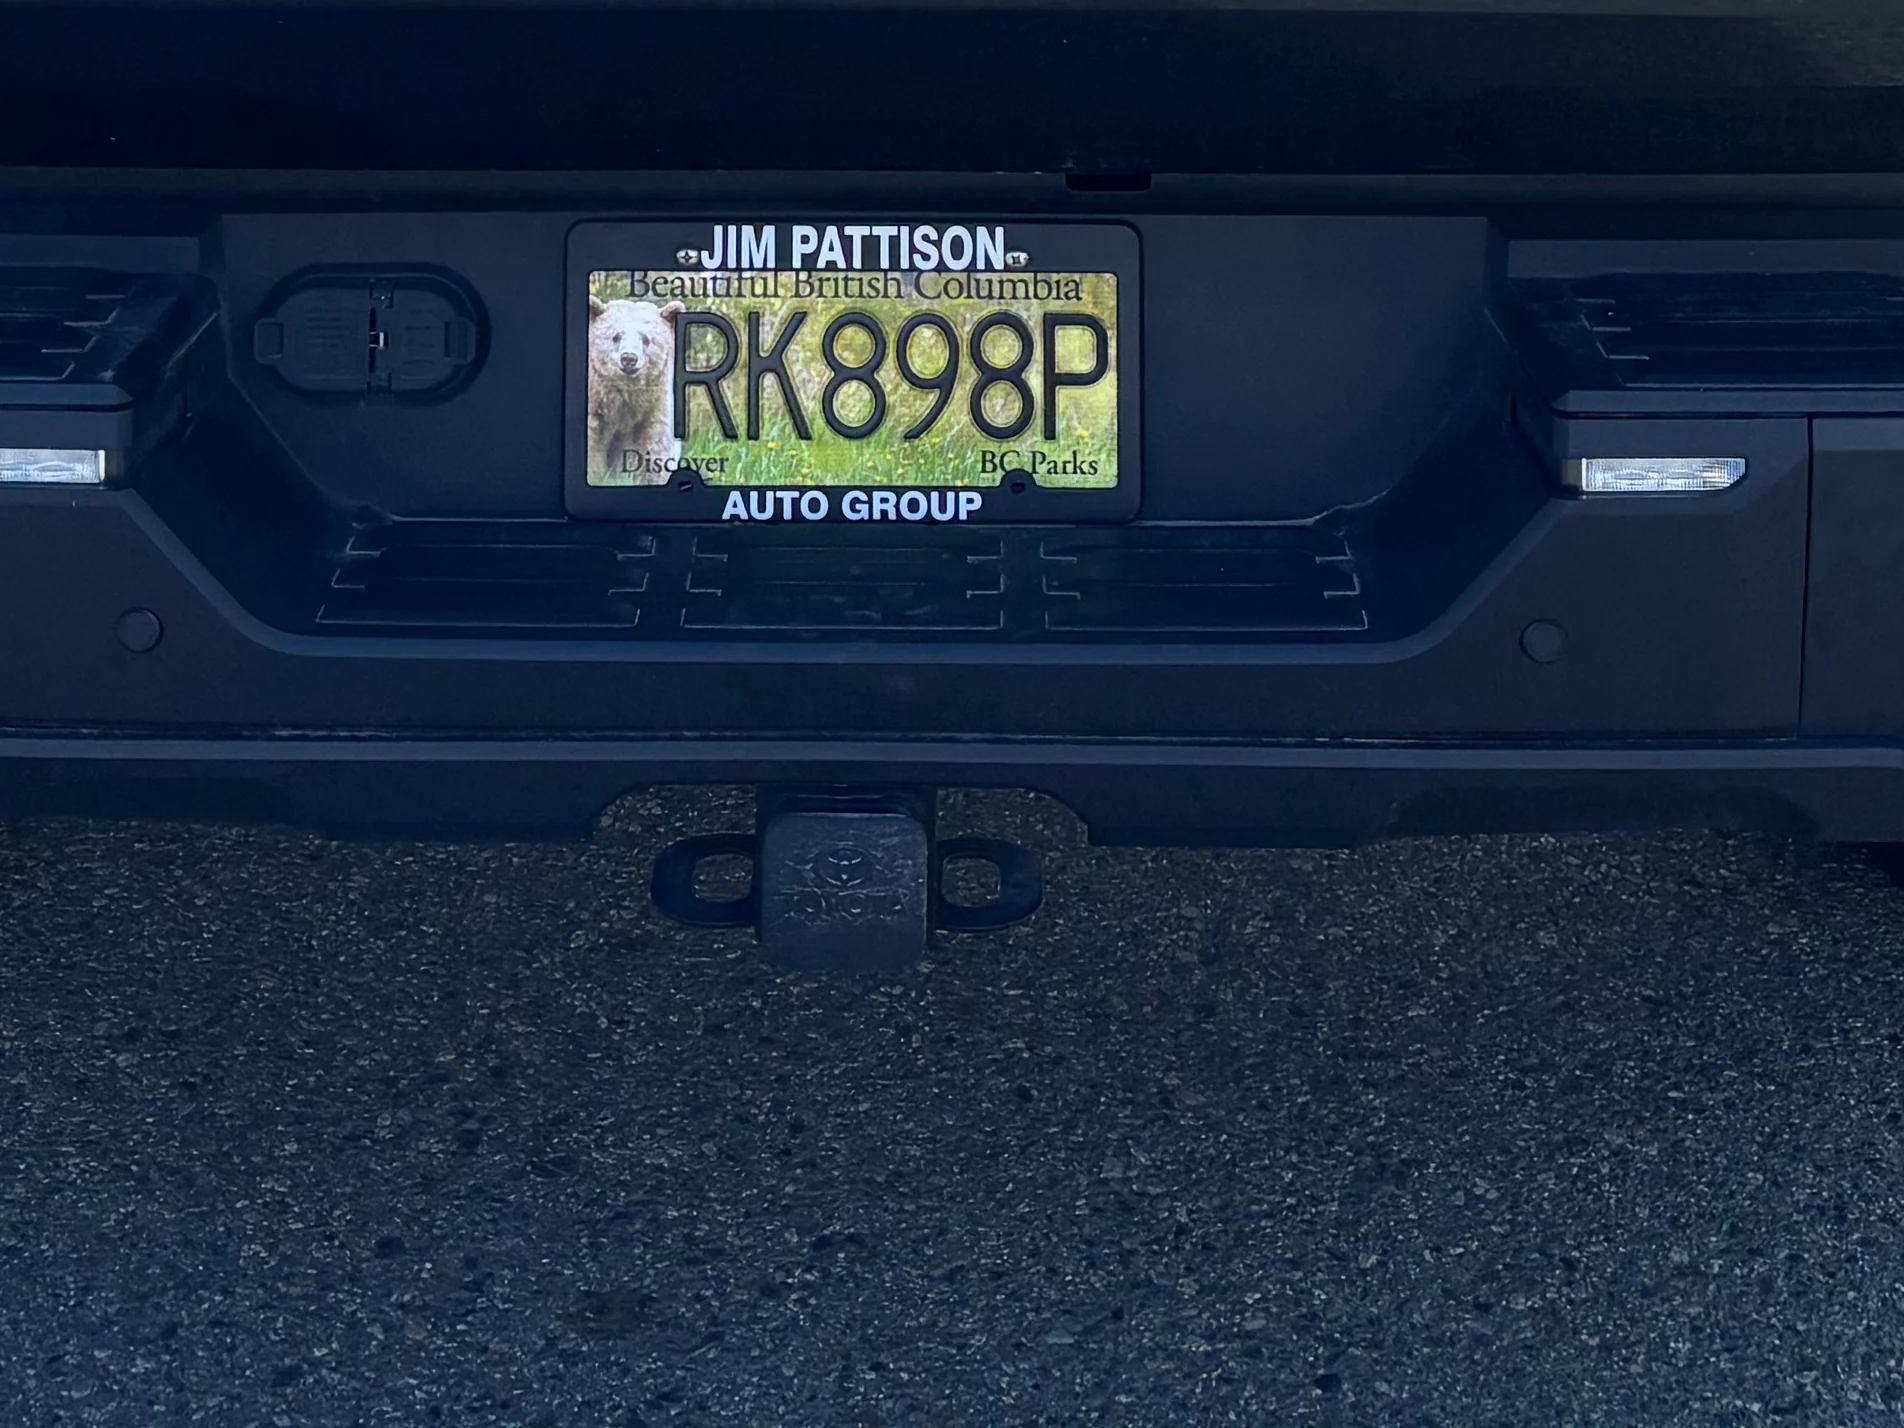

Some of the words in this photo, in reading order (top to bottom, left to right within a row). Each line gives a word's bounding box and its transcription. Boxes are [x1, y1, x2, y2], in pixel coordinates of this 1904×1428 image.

[701, 224, 777, 271] JIM
[792, 224, 1005, 271] PATTISON
[628, 271, 780, 300] Beautiful
[793, 271, 905, 300] British
[913, 271, 1084, 302] Columbia
[673, 310, 1109, 442] RK898P
[621, 448, 730, 474] Discover
[979, 450, 1023, 475] BC
[1031, 450, 1099, 476] Parks
[721, 489, 830, 522] AUTO
[841, 489, 984, 522] GROUP
